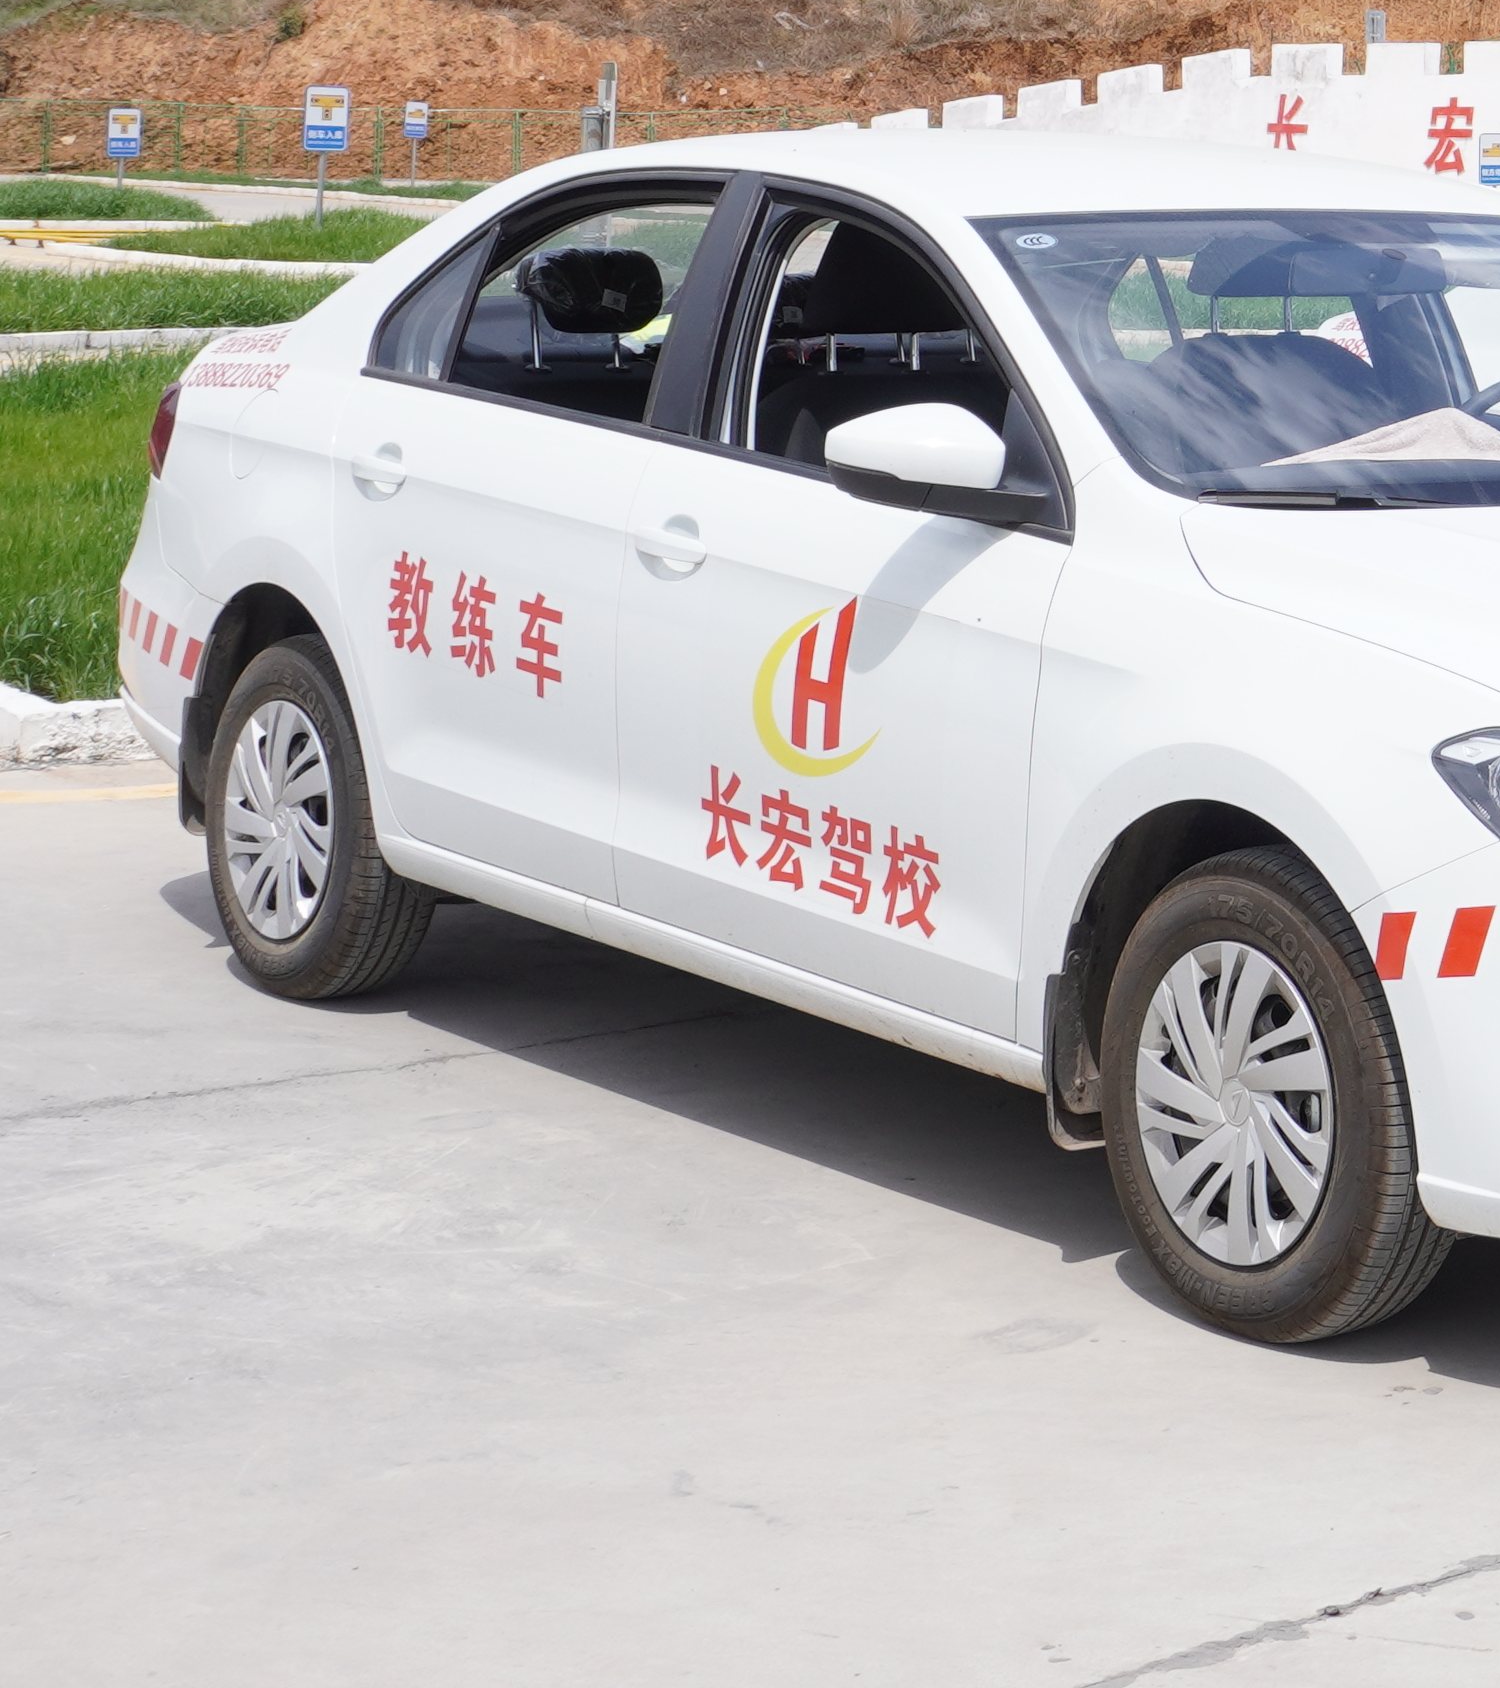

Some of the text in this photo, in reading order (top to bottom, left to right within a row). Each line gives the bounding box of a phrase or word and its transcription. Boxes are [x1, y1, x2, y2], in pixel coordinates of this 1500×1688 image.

[387, 551, 563, 699] 教练车
[701, 765, 943, 939] 长宏驾校
